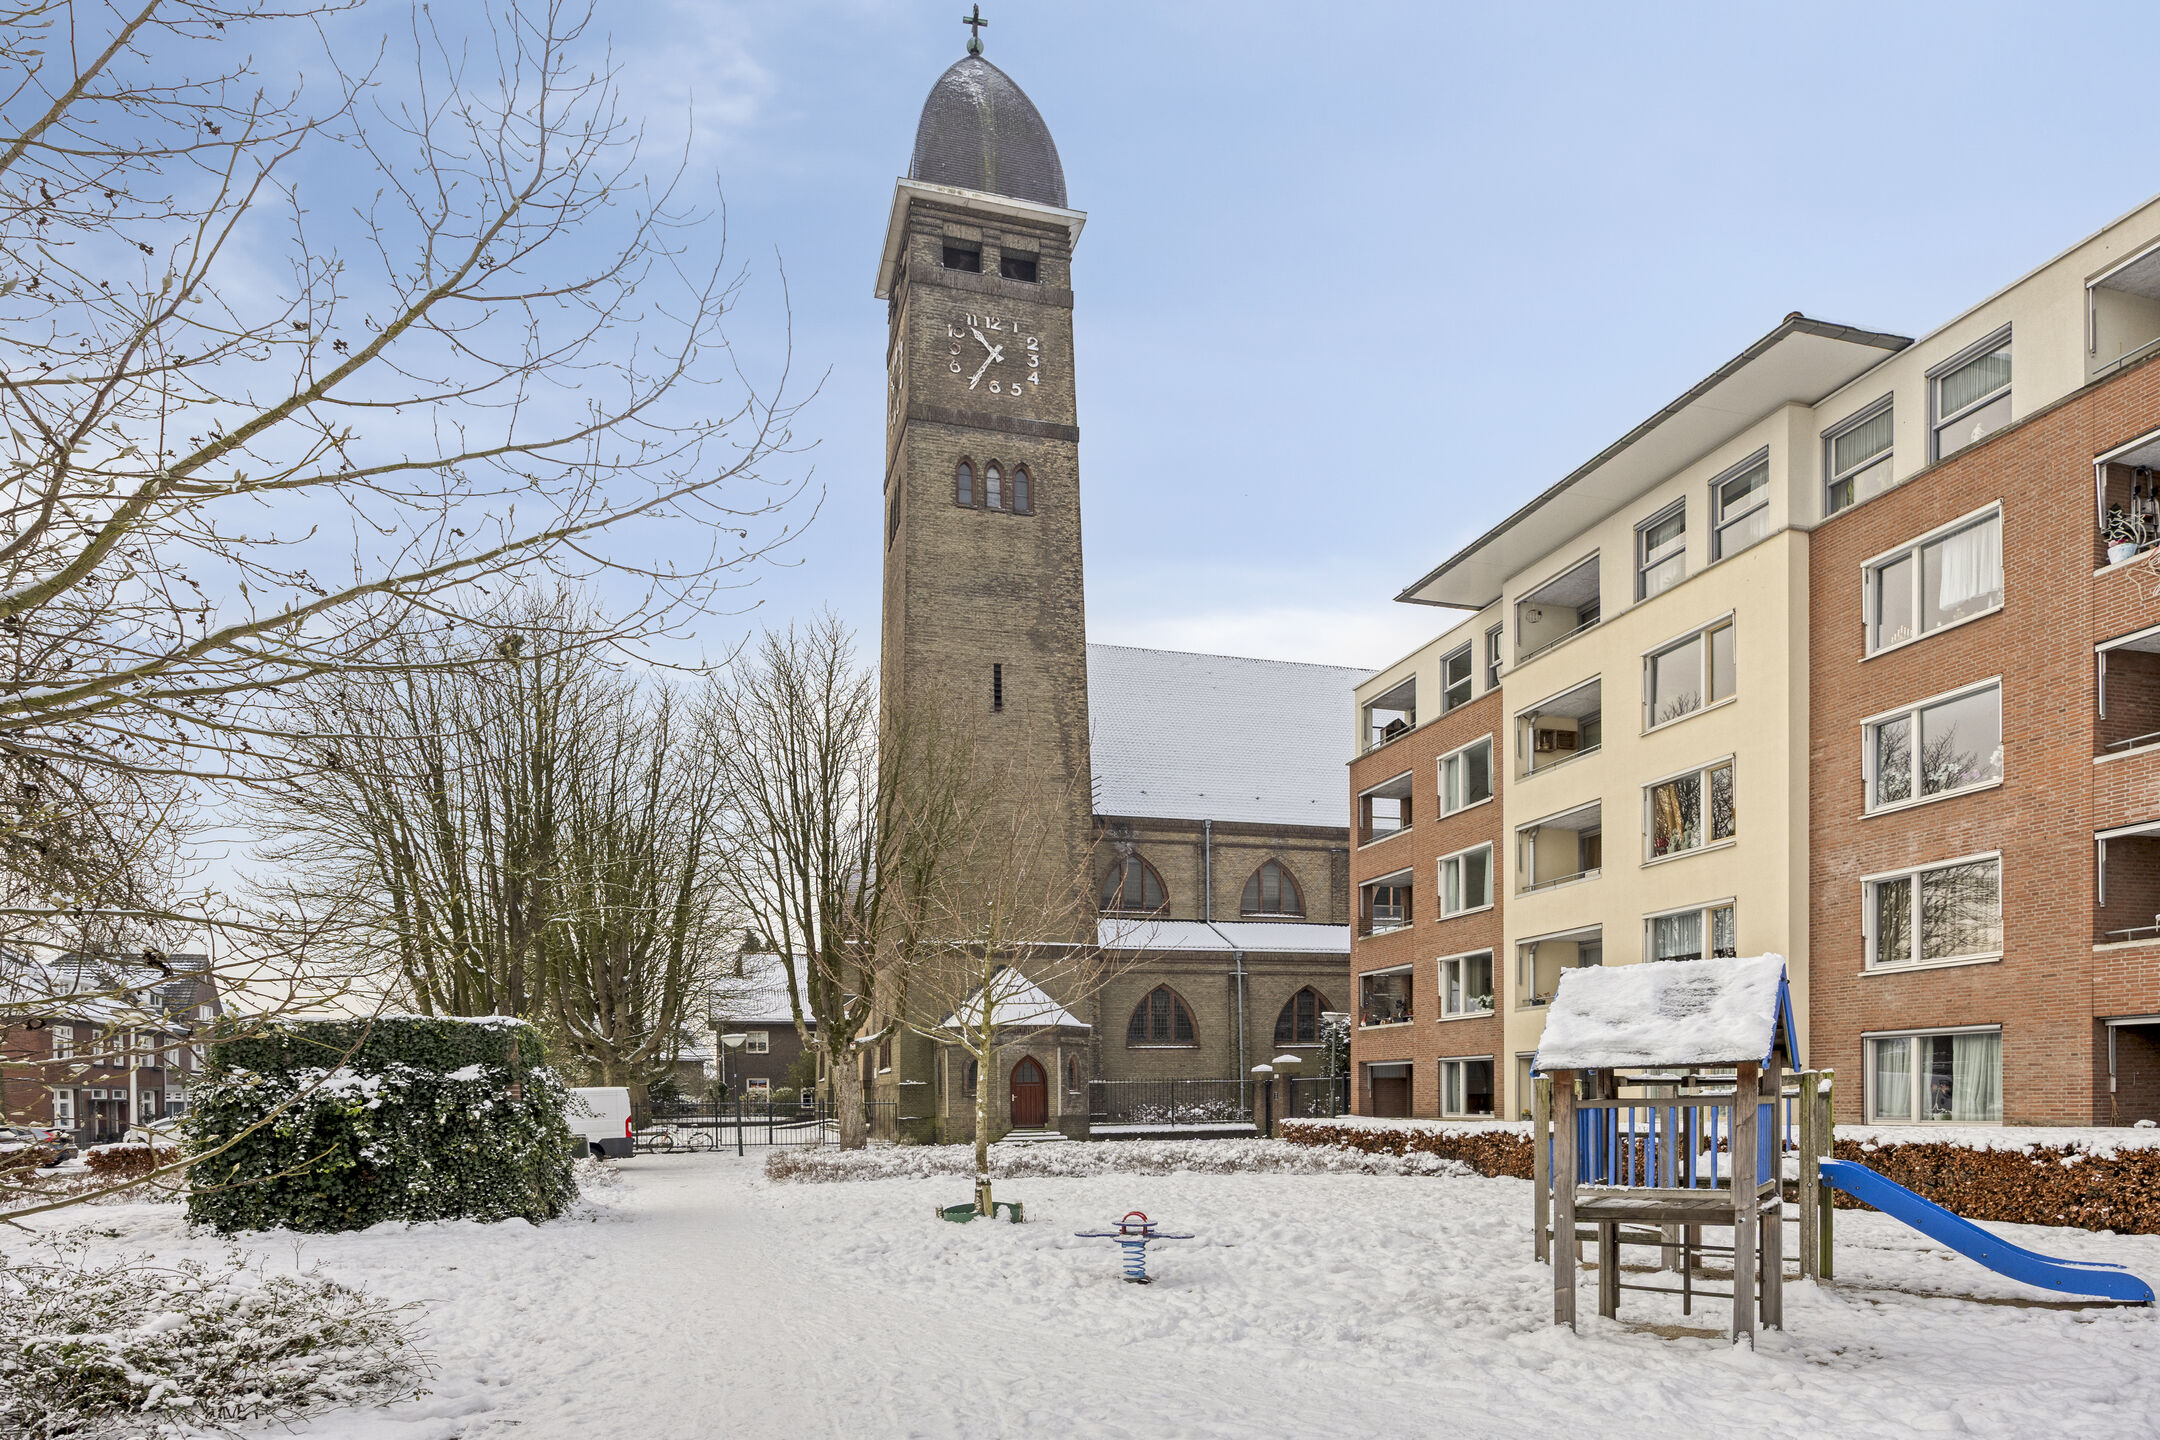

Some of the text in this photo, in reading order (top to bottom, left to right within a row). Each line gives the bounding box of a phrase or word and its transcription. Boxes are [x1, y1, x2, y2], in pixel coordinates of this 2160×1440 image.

[965, 312, 978, 327] 11
[985, 316, 1002, 331] 12
[1013, 321, 1018, 333] 1
[947, 323, 965, 338] 10
[1026, 336, 1039, 351] 2
[1027, 353, 1039, 368] 3
[1027, 371, 1040, 385] 4
[988, 380, 1001, 394] 6
[1010, 383, 1022, 396] 5
